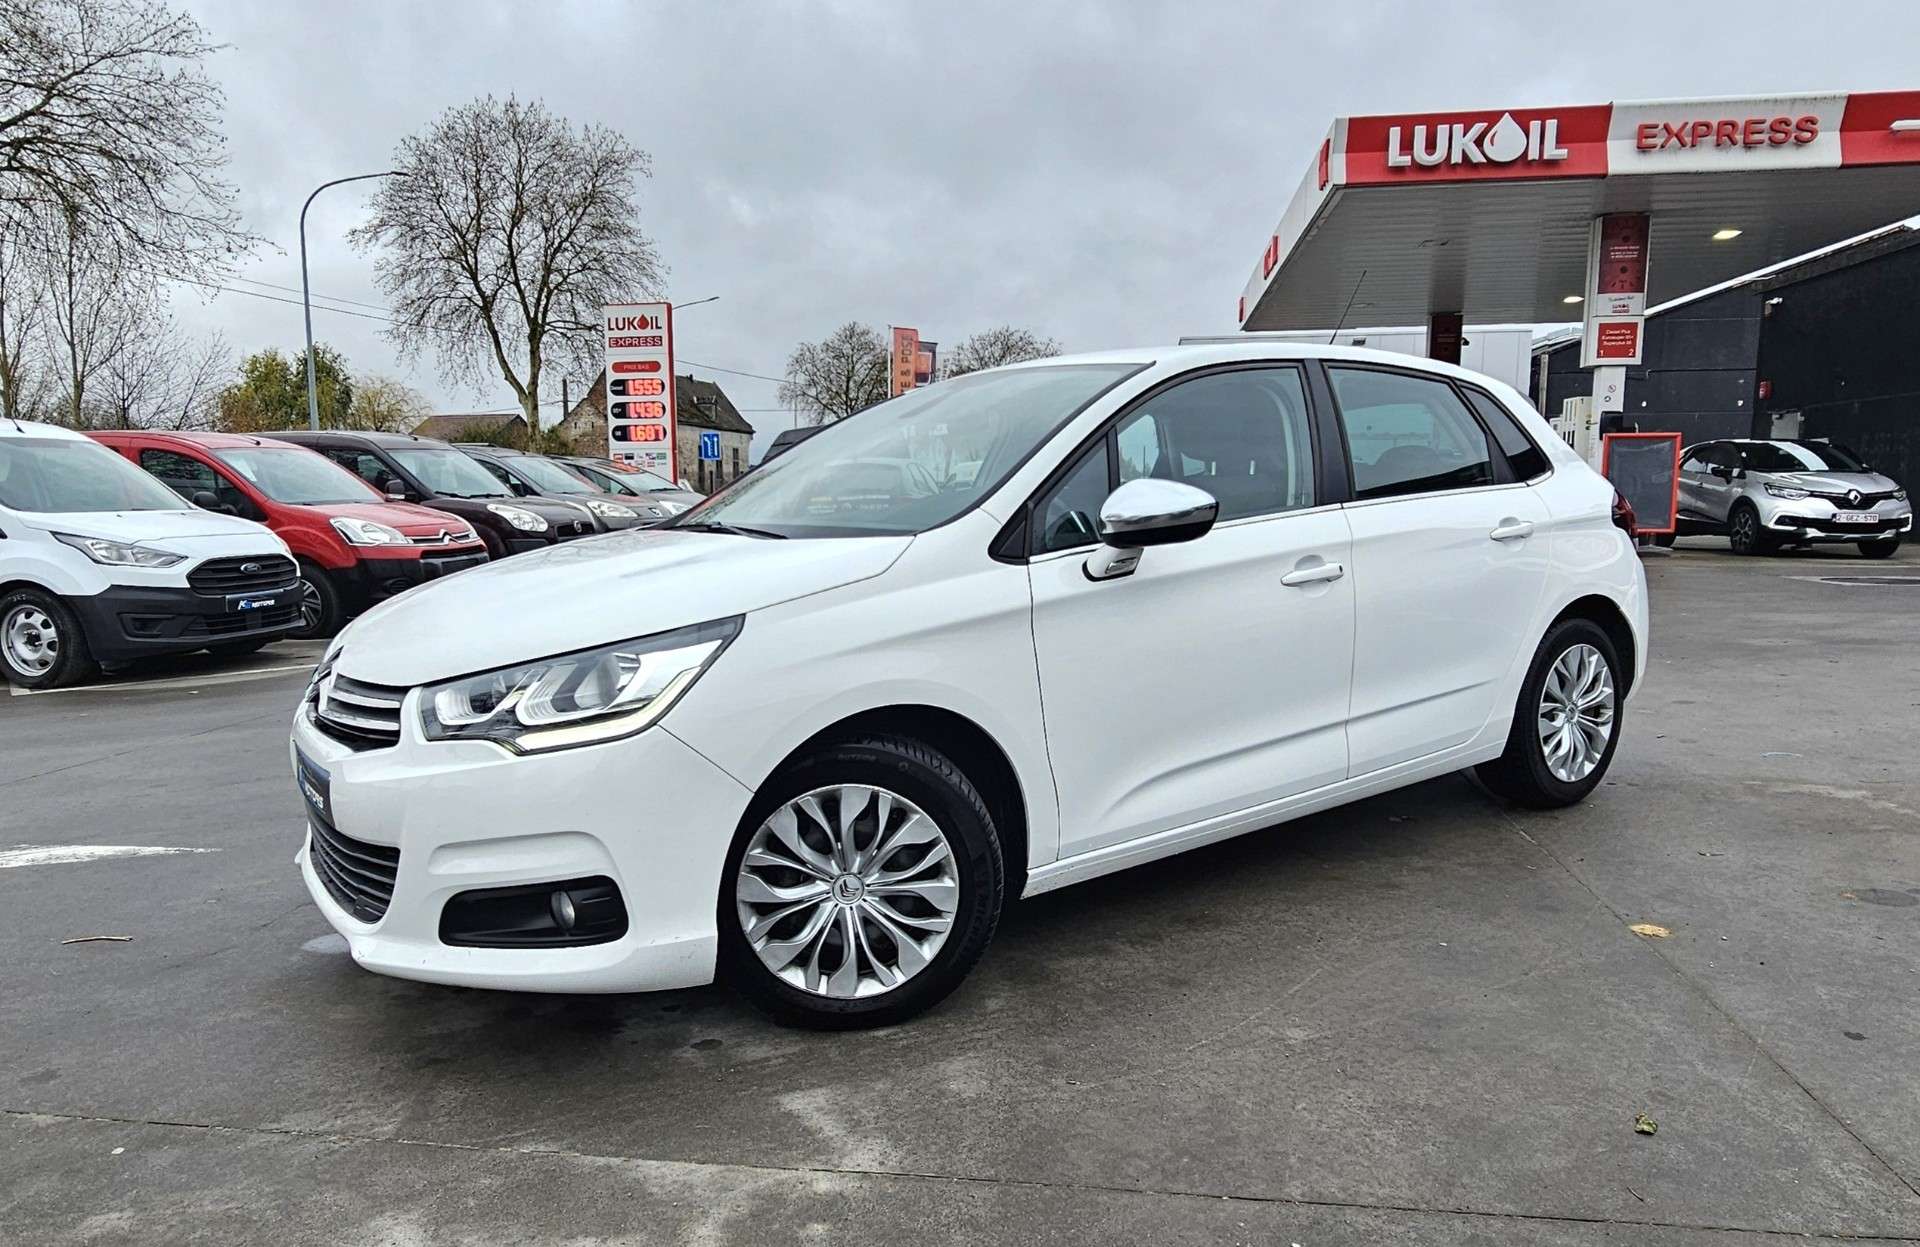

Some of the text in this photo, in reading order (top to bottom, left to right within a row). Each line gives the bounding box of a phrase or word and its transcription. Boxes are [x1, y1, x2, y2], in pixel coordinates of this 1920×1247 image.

[1387, 112, 1820, 167] LUKOIL EXPRESS
[608, 314, 663, 331] LUKOIL
[610, 337, 661, 347] EXPRESS
[1628, 348, 1634, 356] 2
